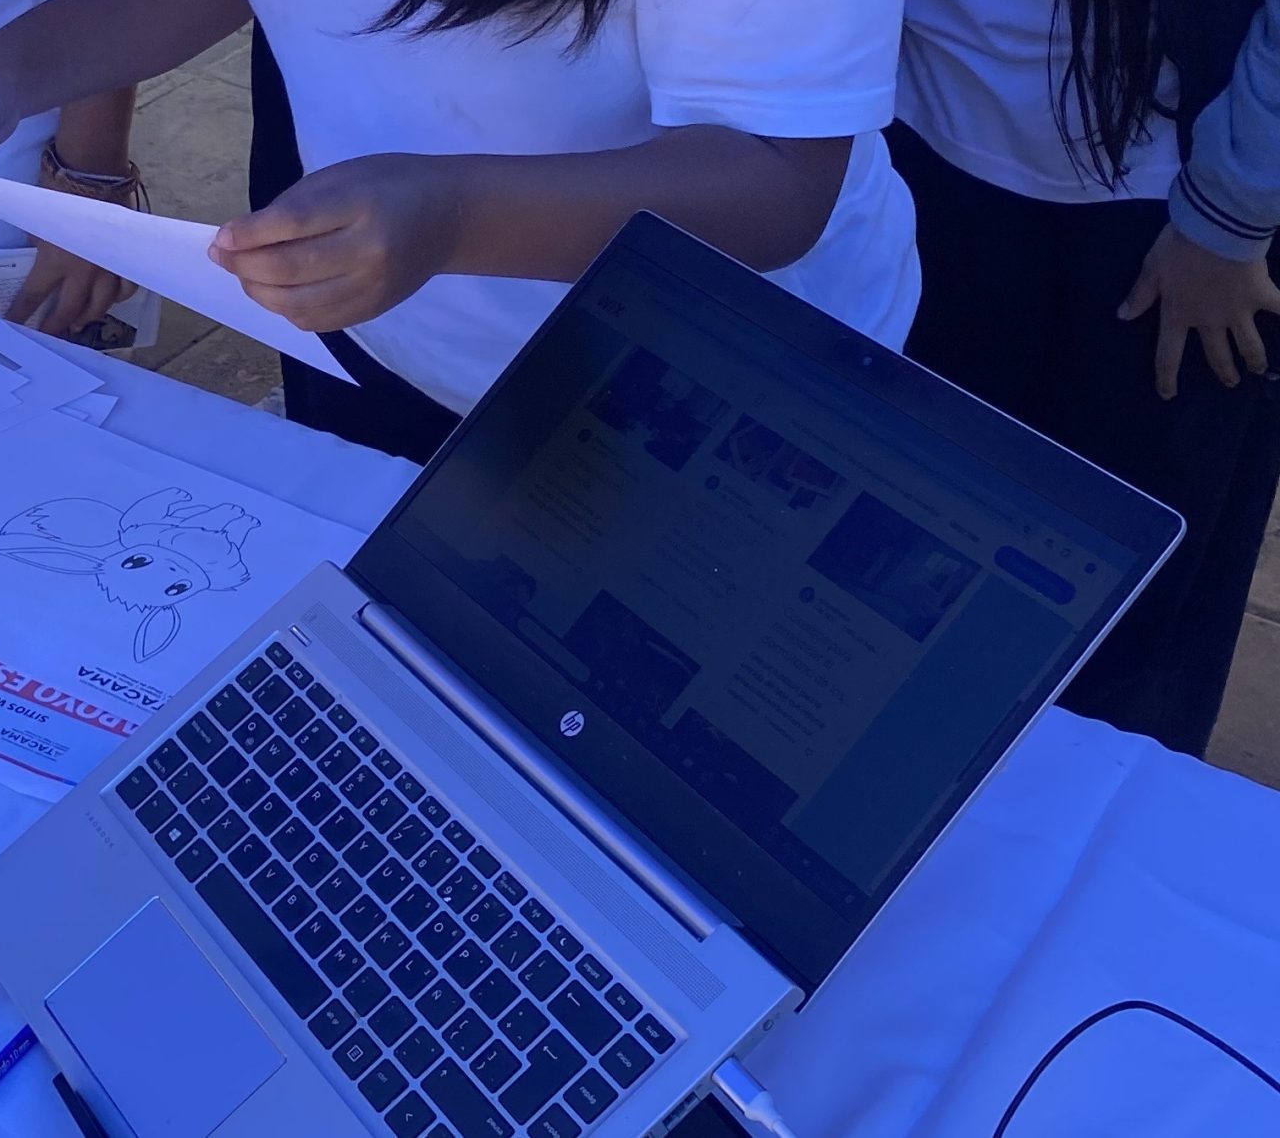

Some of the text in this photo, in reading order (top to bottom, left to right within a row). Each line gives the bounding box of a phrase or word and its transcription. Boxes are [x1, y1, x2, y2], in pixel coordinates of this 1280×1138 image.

[7, 700, 50, 725] SITIOS
[222, 819, 231, 828] X
[266, 869, 275, 879] V
[287, 895, 297, 904] B
[310, 922, 320, 933] N
[334, 950, 345, 963] M
[264, 802, 273, 811] D
[309, 853, 318, 862] G
[331, 879, 341, 888] H
[380, 933, 391, 943] K
[289, 766, 298, 776] E
[311, 791, 321, 801] R
[335, 816, 344, 825] T
[359, 841, 369, 851] Y
[382, 869, 392, 877] U
[459, 950, 469, 960] P
